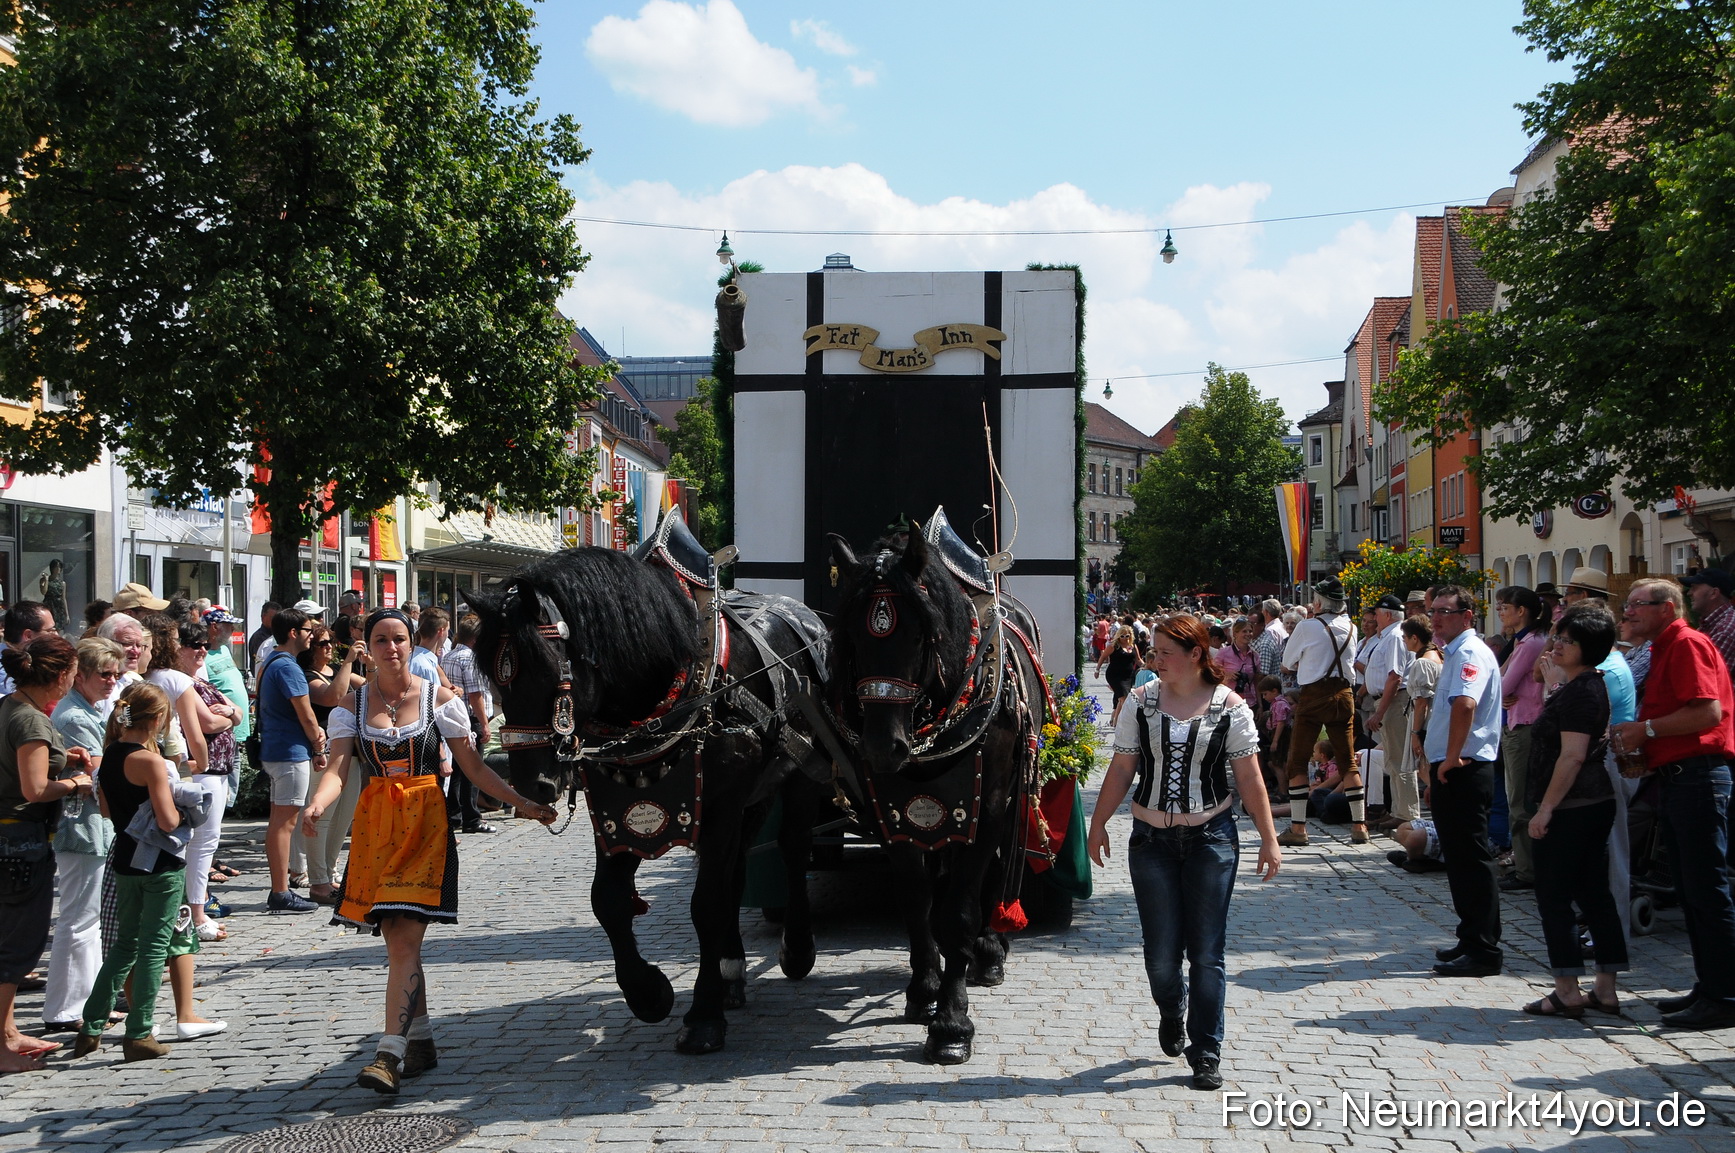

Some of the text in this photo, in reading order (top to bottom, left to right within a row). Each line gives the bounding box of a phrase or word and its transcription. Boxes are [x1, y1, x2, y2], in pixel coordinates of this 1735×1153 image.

[826, 326, 974, 368] Fat Man's Inn
[1441, 528, 1463, 536] MATT
